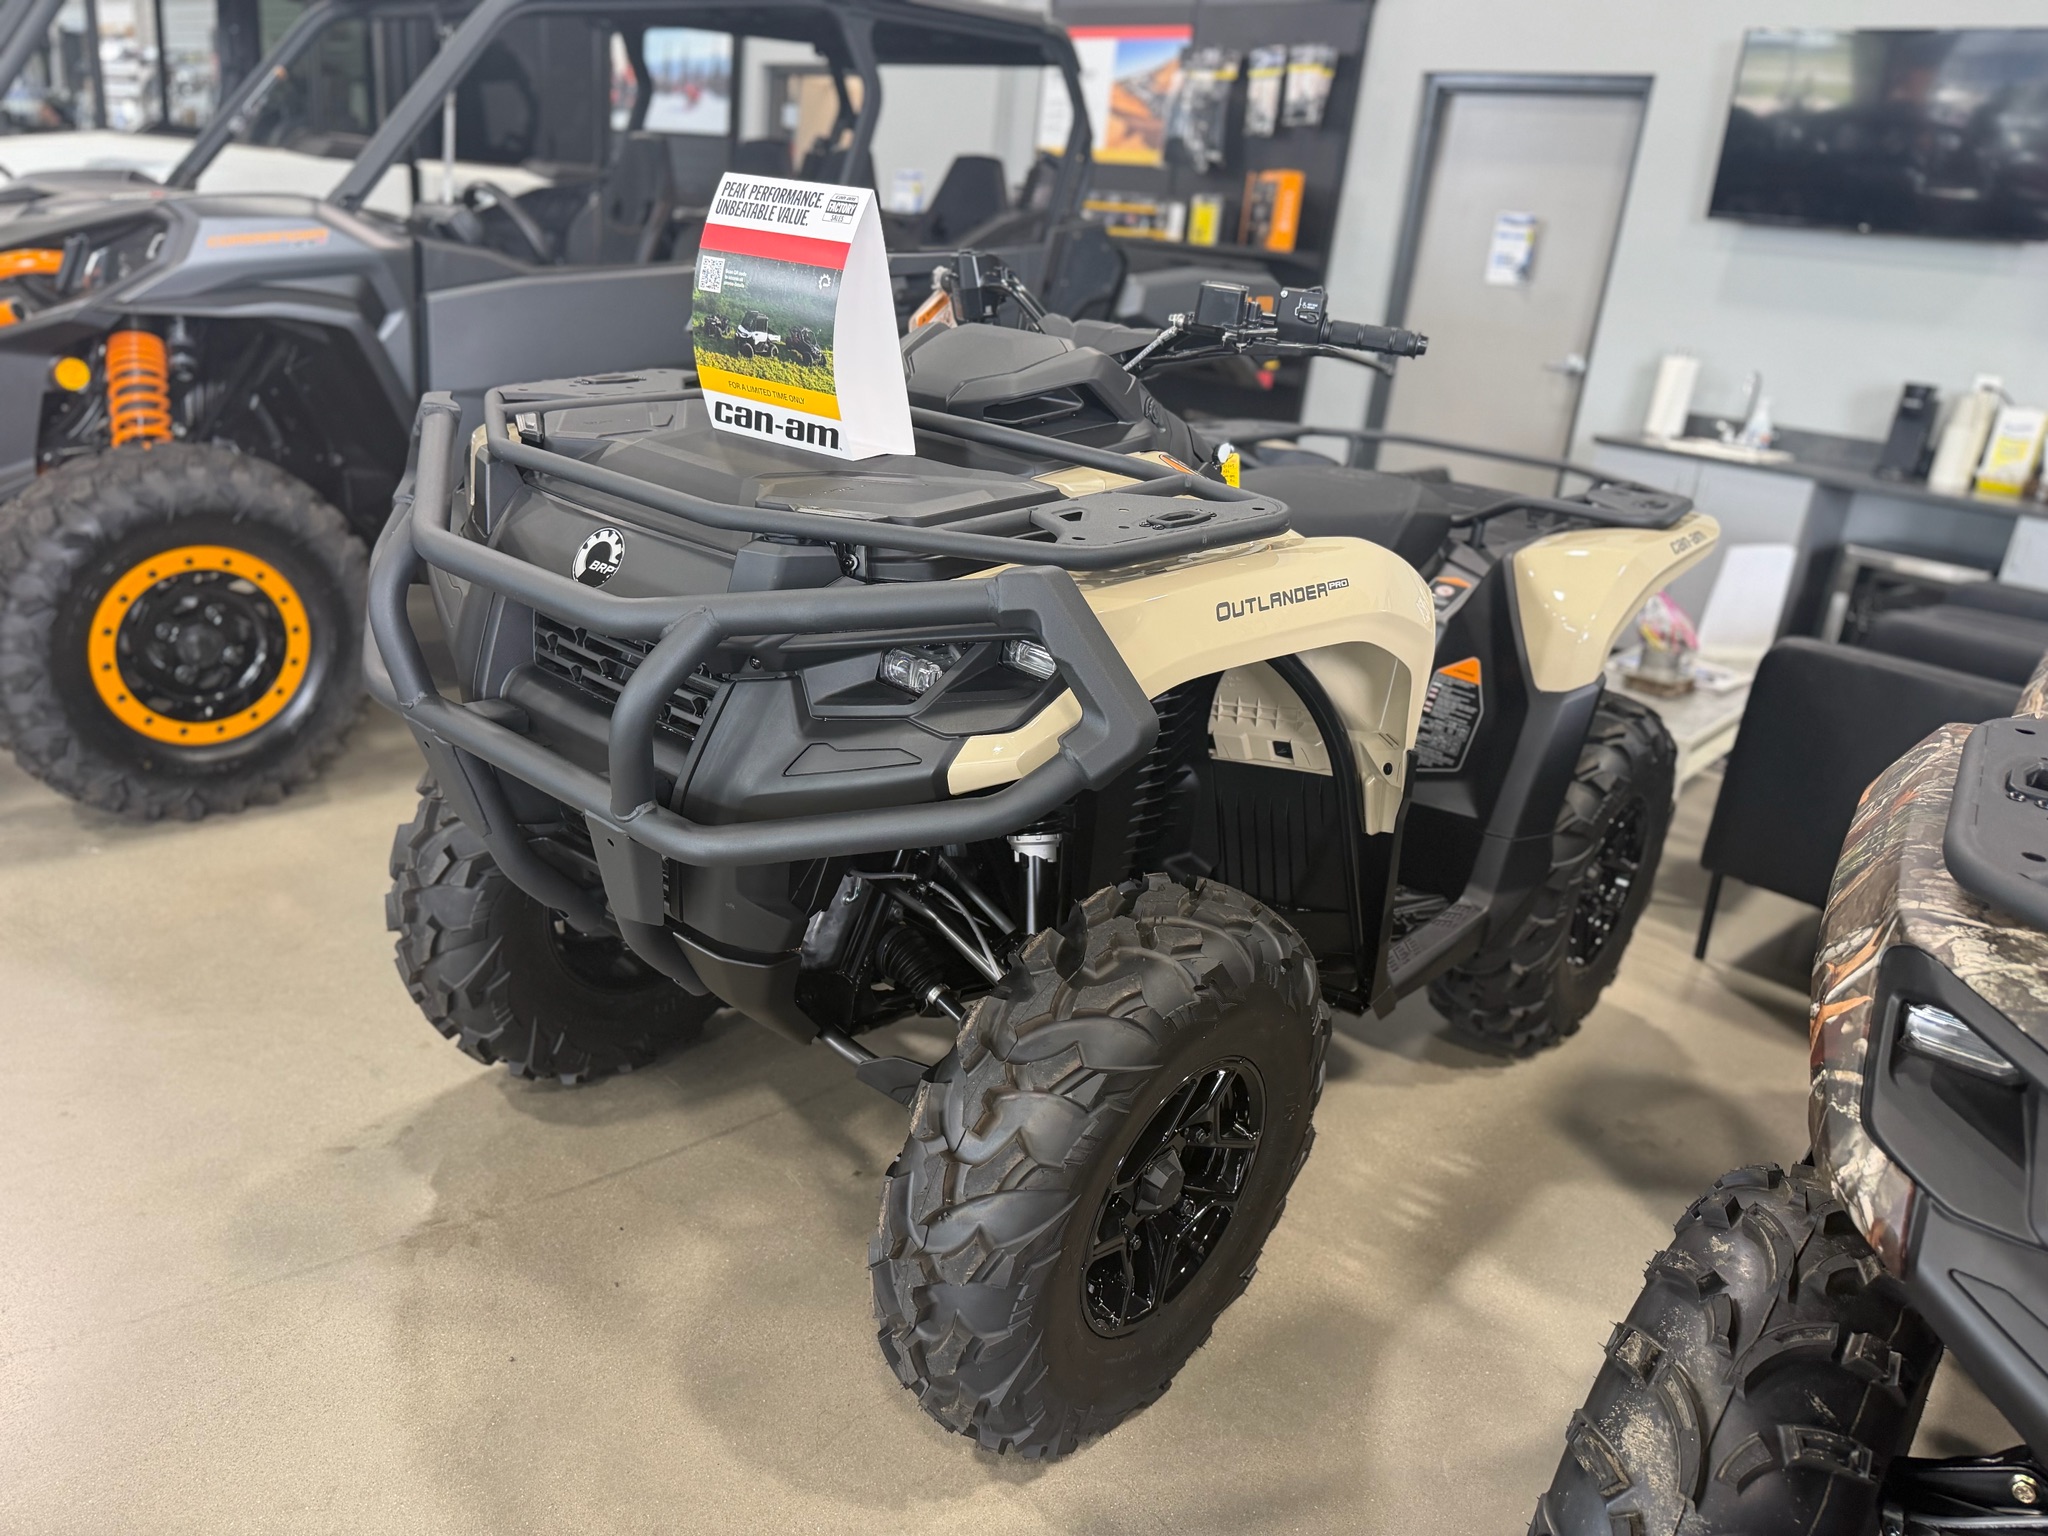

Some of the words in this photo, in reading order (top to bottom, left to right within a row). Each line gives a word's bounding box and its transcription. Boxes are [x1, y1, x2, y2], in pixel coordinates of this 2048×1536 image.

[721, 181, 750, 199] PEAK
[748, 184, 824, 209] PERFORMANCE.
[827, 200, 858, 215] FACTORY
[715, 198, 777, 222] UNBEATABLE
[776, 206, 810, 226] VALUE.
[830, 213, 845, 223] SALES
[728, 380, 741, 389] FOR
[746, 385, 772, 397] LIMITED
[772, 390, 788, 401] TIME
[788, 394, 805, 405] ONLY
[714, 400, 839, 450] can-am
[588, 559, 616, 574] BRP
[1216, 582, 1329, 622] OUTLANDER
[1328, 578, 1349, 591] PRO
